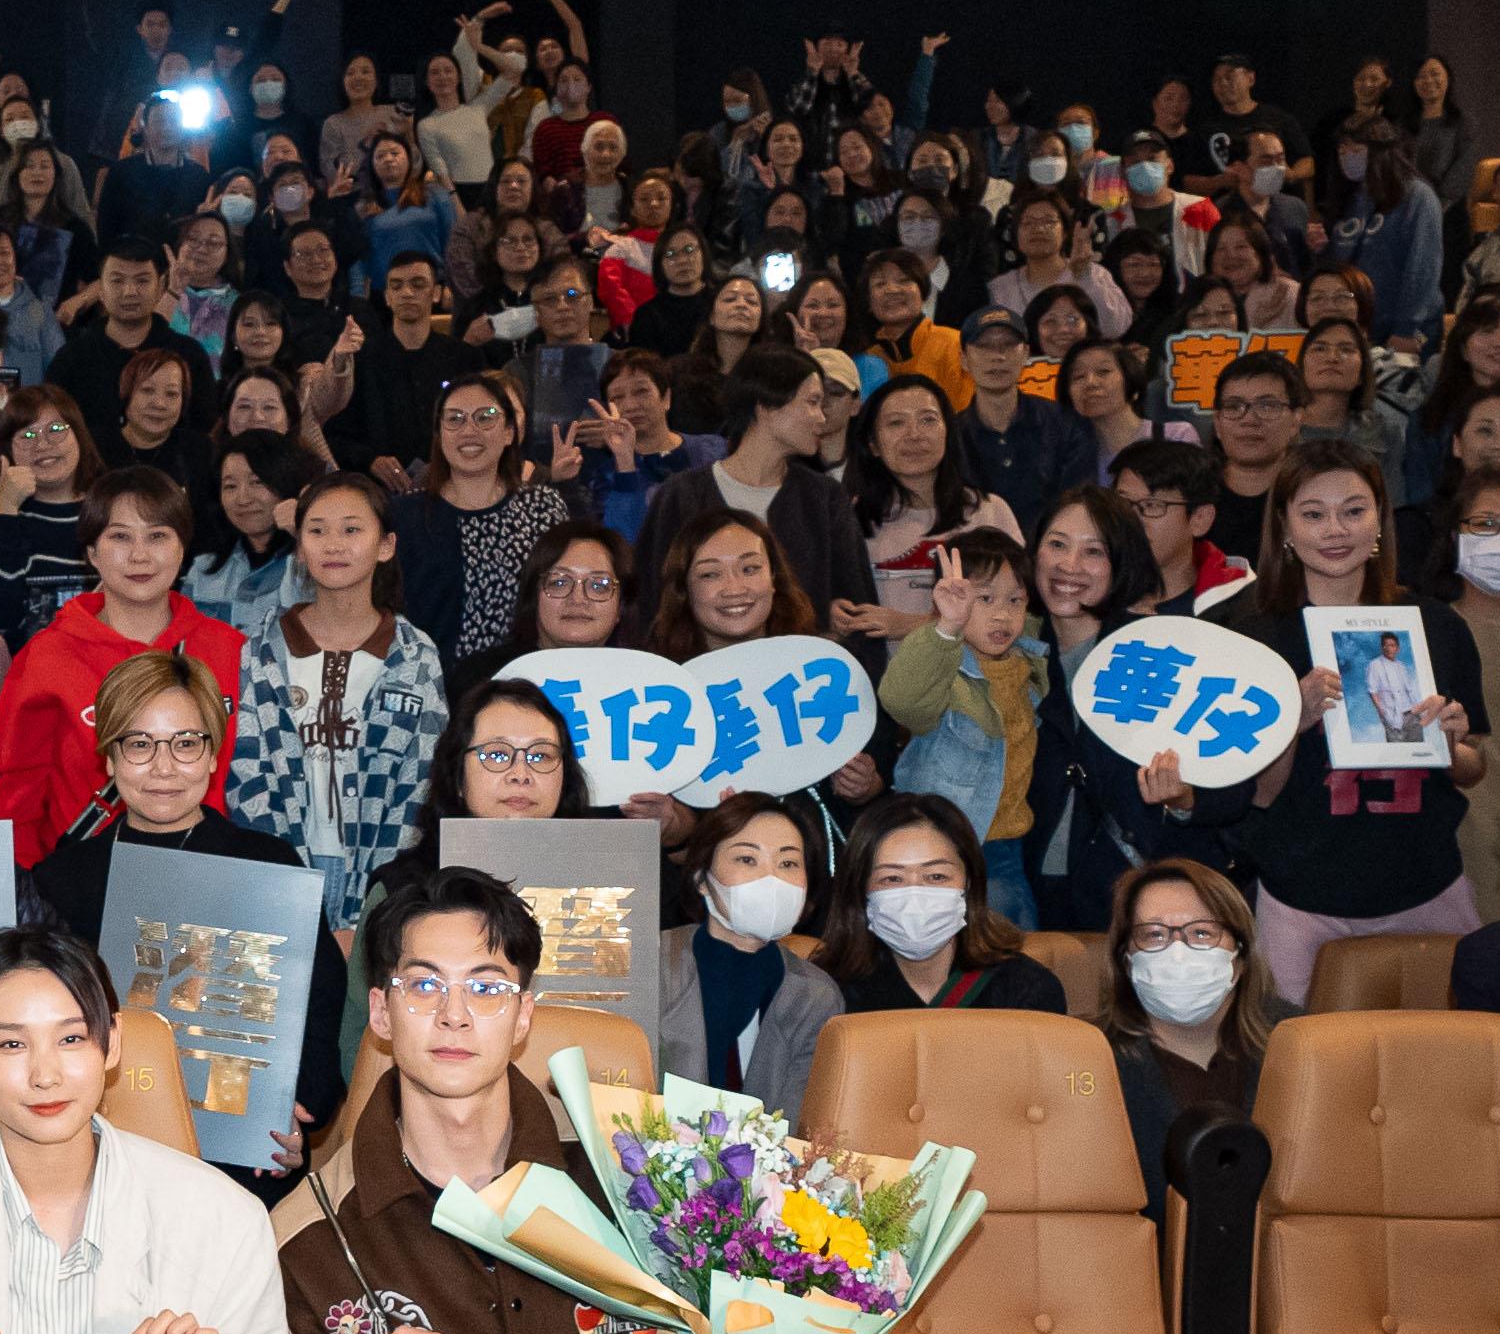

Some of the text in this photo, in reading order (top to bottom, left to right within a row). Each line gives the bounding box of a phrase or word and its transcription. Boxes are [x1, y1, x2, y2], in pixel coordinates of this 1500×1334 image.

[1092, 640, 1281, 758] 華仔
[125, 1067, 154, 1091] 15
[601, 1068, 630, 1087] 14
[1065, 1071, 1095, 1095] 13
